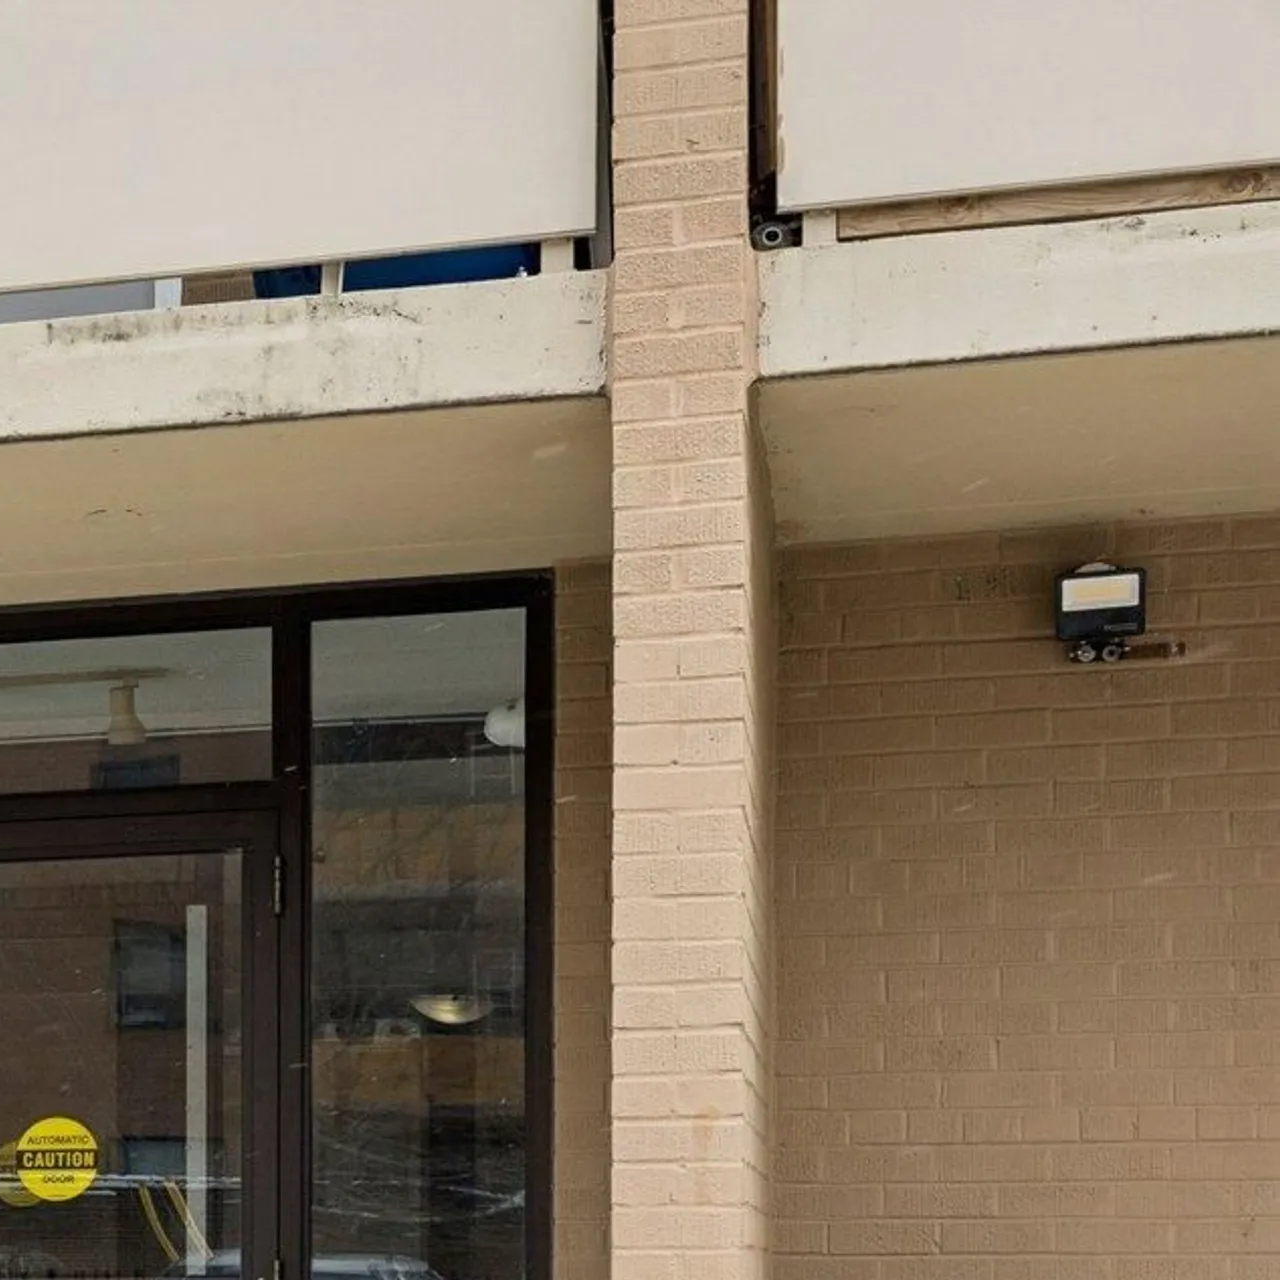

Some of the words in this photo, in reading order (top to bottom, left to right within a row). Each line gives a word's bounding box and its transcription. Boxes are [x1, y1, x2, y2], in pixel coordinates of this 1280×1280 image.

[27, 1134, 89, 1145] AUTOMATIC
[22, 1151, 95, 1168] CAUTION
[43, 1173, 75, 1184] DOOR
